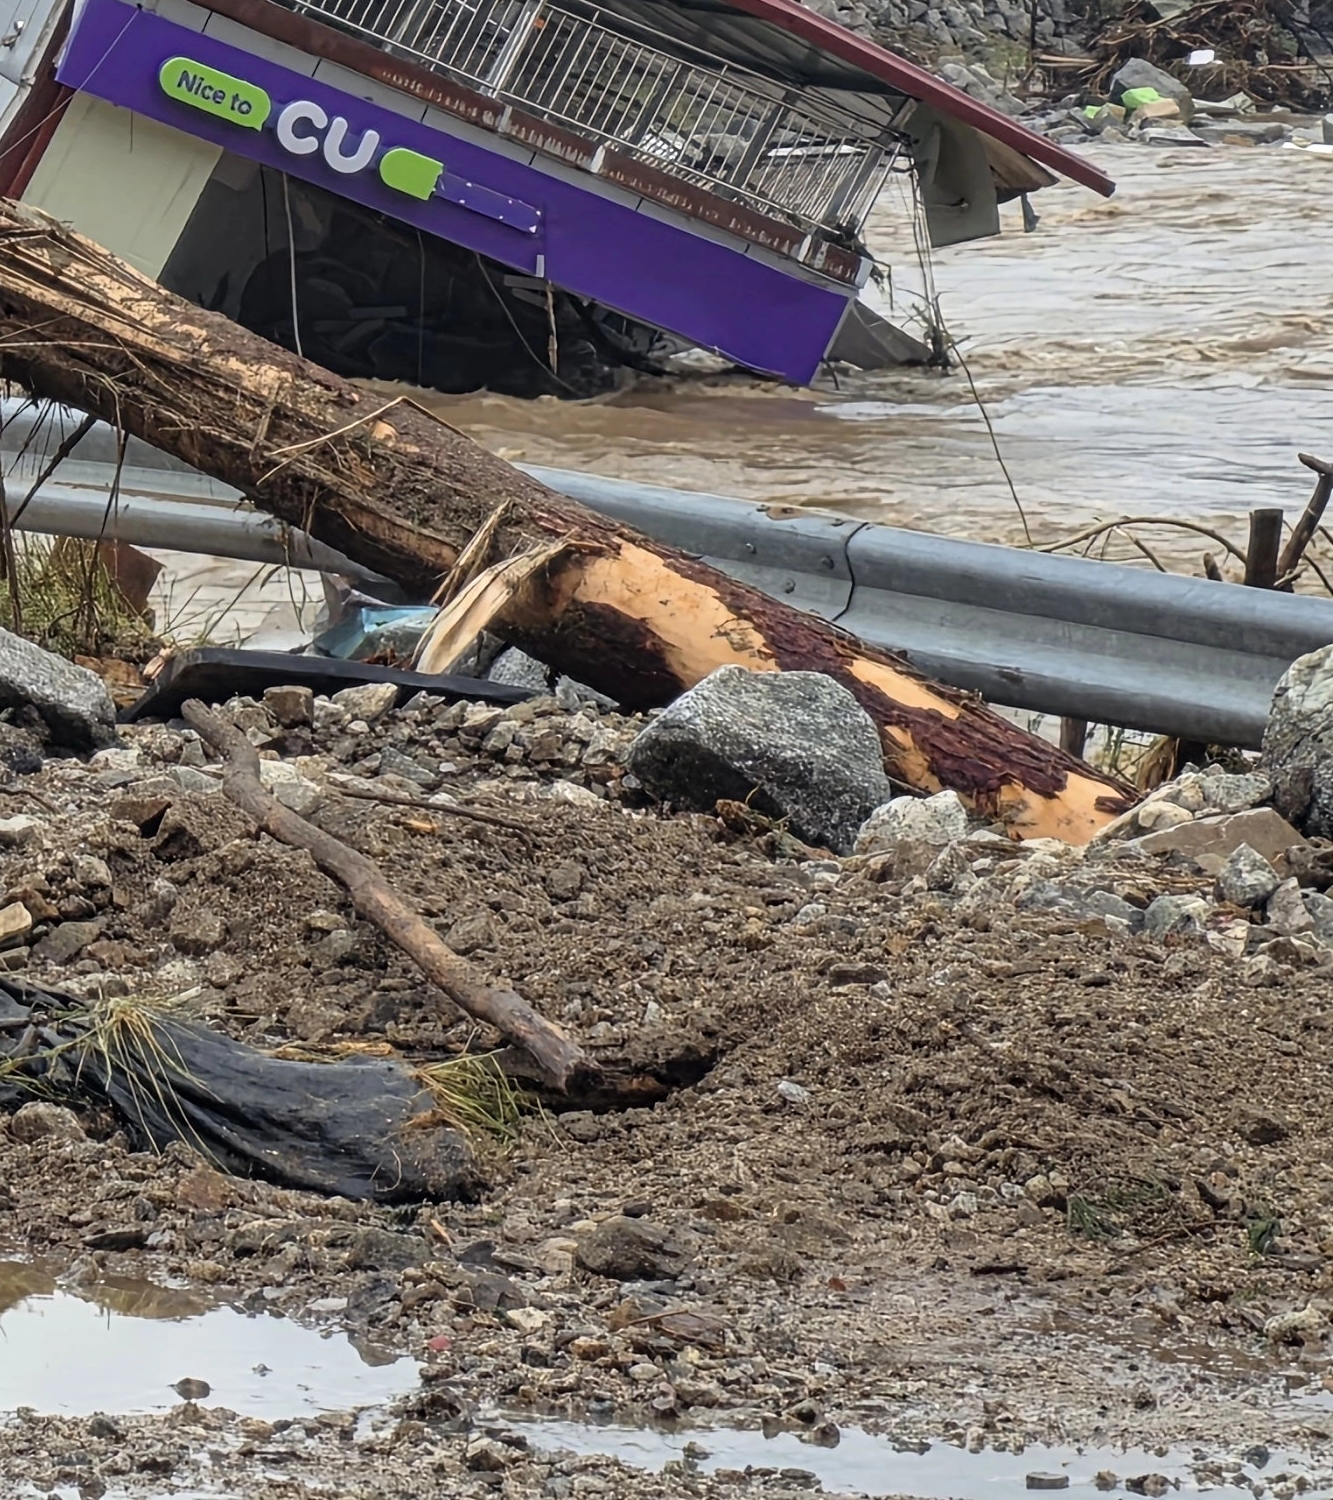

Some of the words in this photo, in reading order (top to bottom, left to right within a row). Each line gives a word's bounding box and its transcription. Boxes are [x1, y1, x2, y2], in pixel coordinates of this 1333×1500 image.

[176, 69, 226, 105] Nice
[230, 92, 253, 116] to
[277, 100, 381, 174] CU
